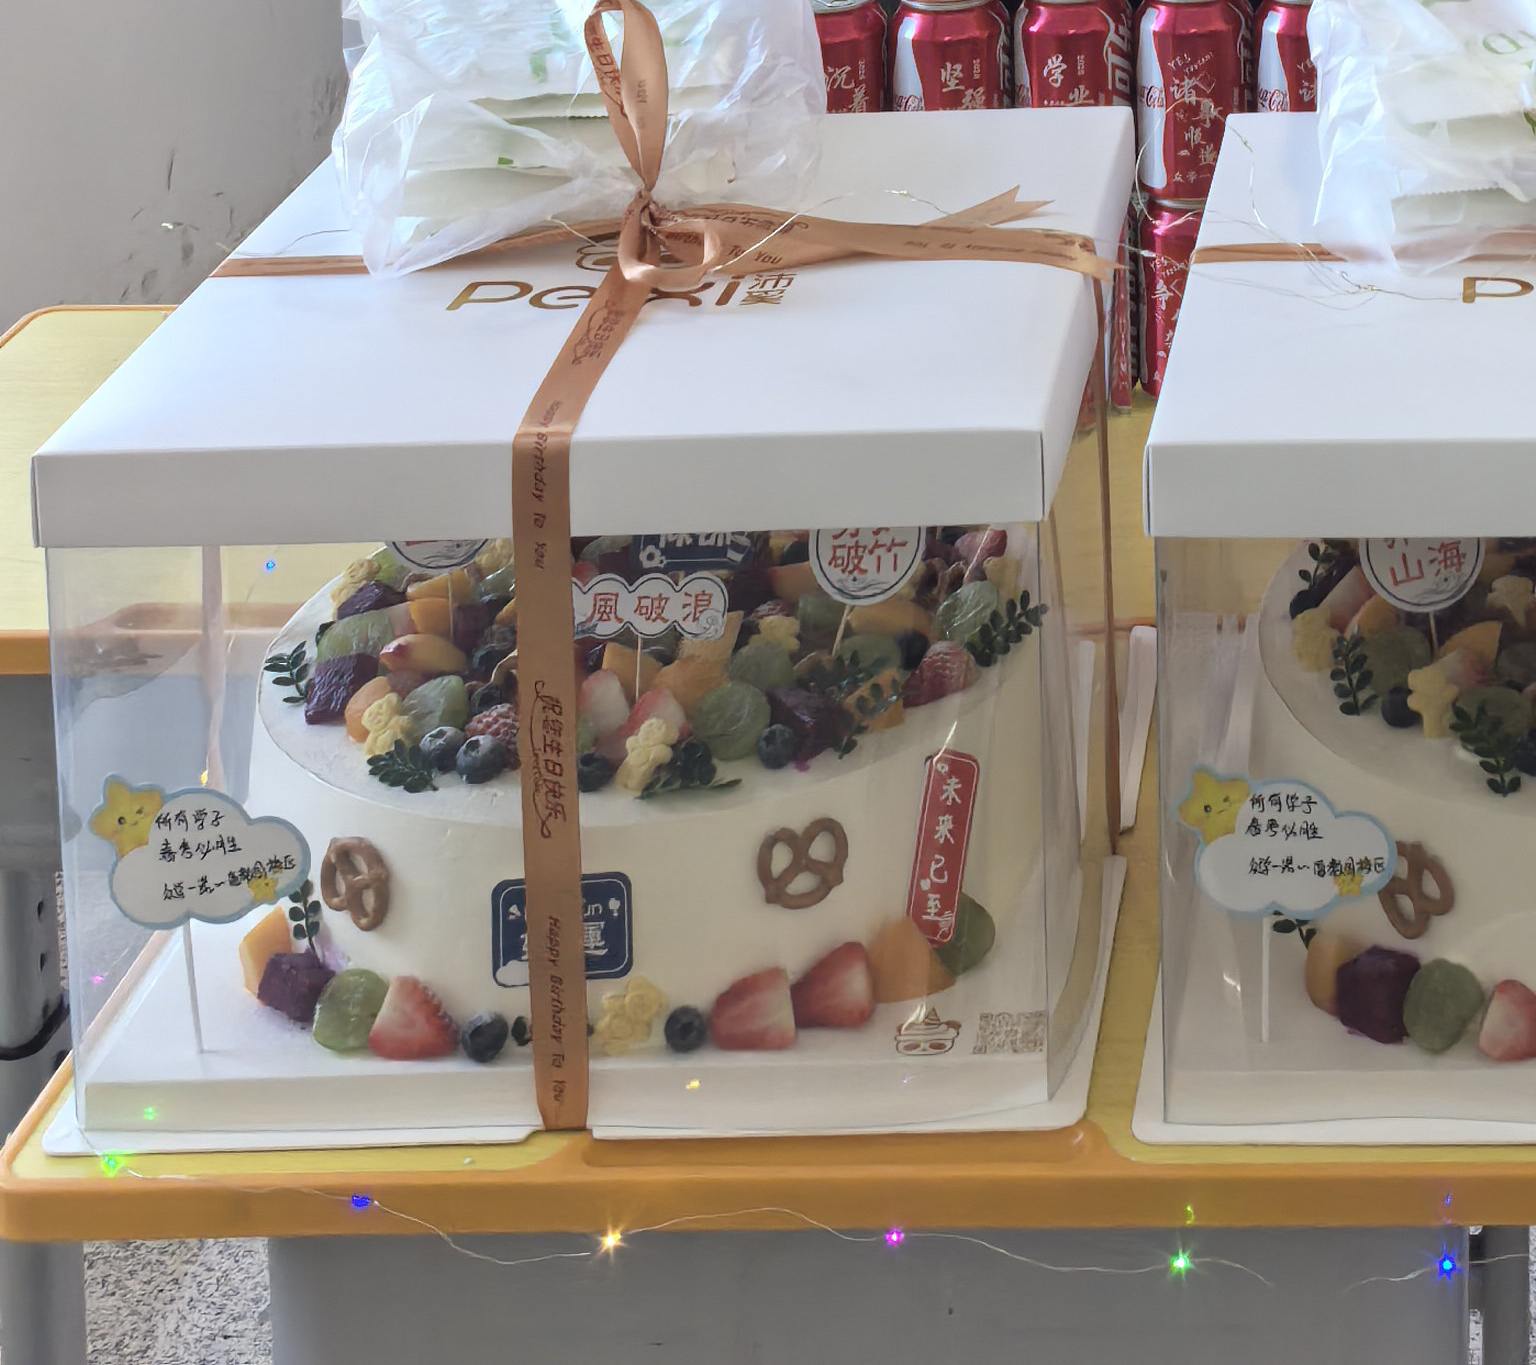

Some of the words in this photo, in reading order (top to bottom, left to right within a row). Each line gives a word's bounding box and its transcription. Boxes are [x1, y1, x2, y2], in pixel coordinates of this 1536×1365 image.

[829, 537, 908, 575] 破竹
[549, 916, 563, 966] Happy
[549, 973, 565, 1044] Birthday
